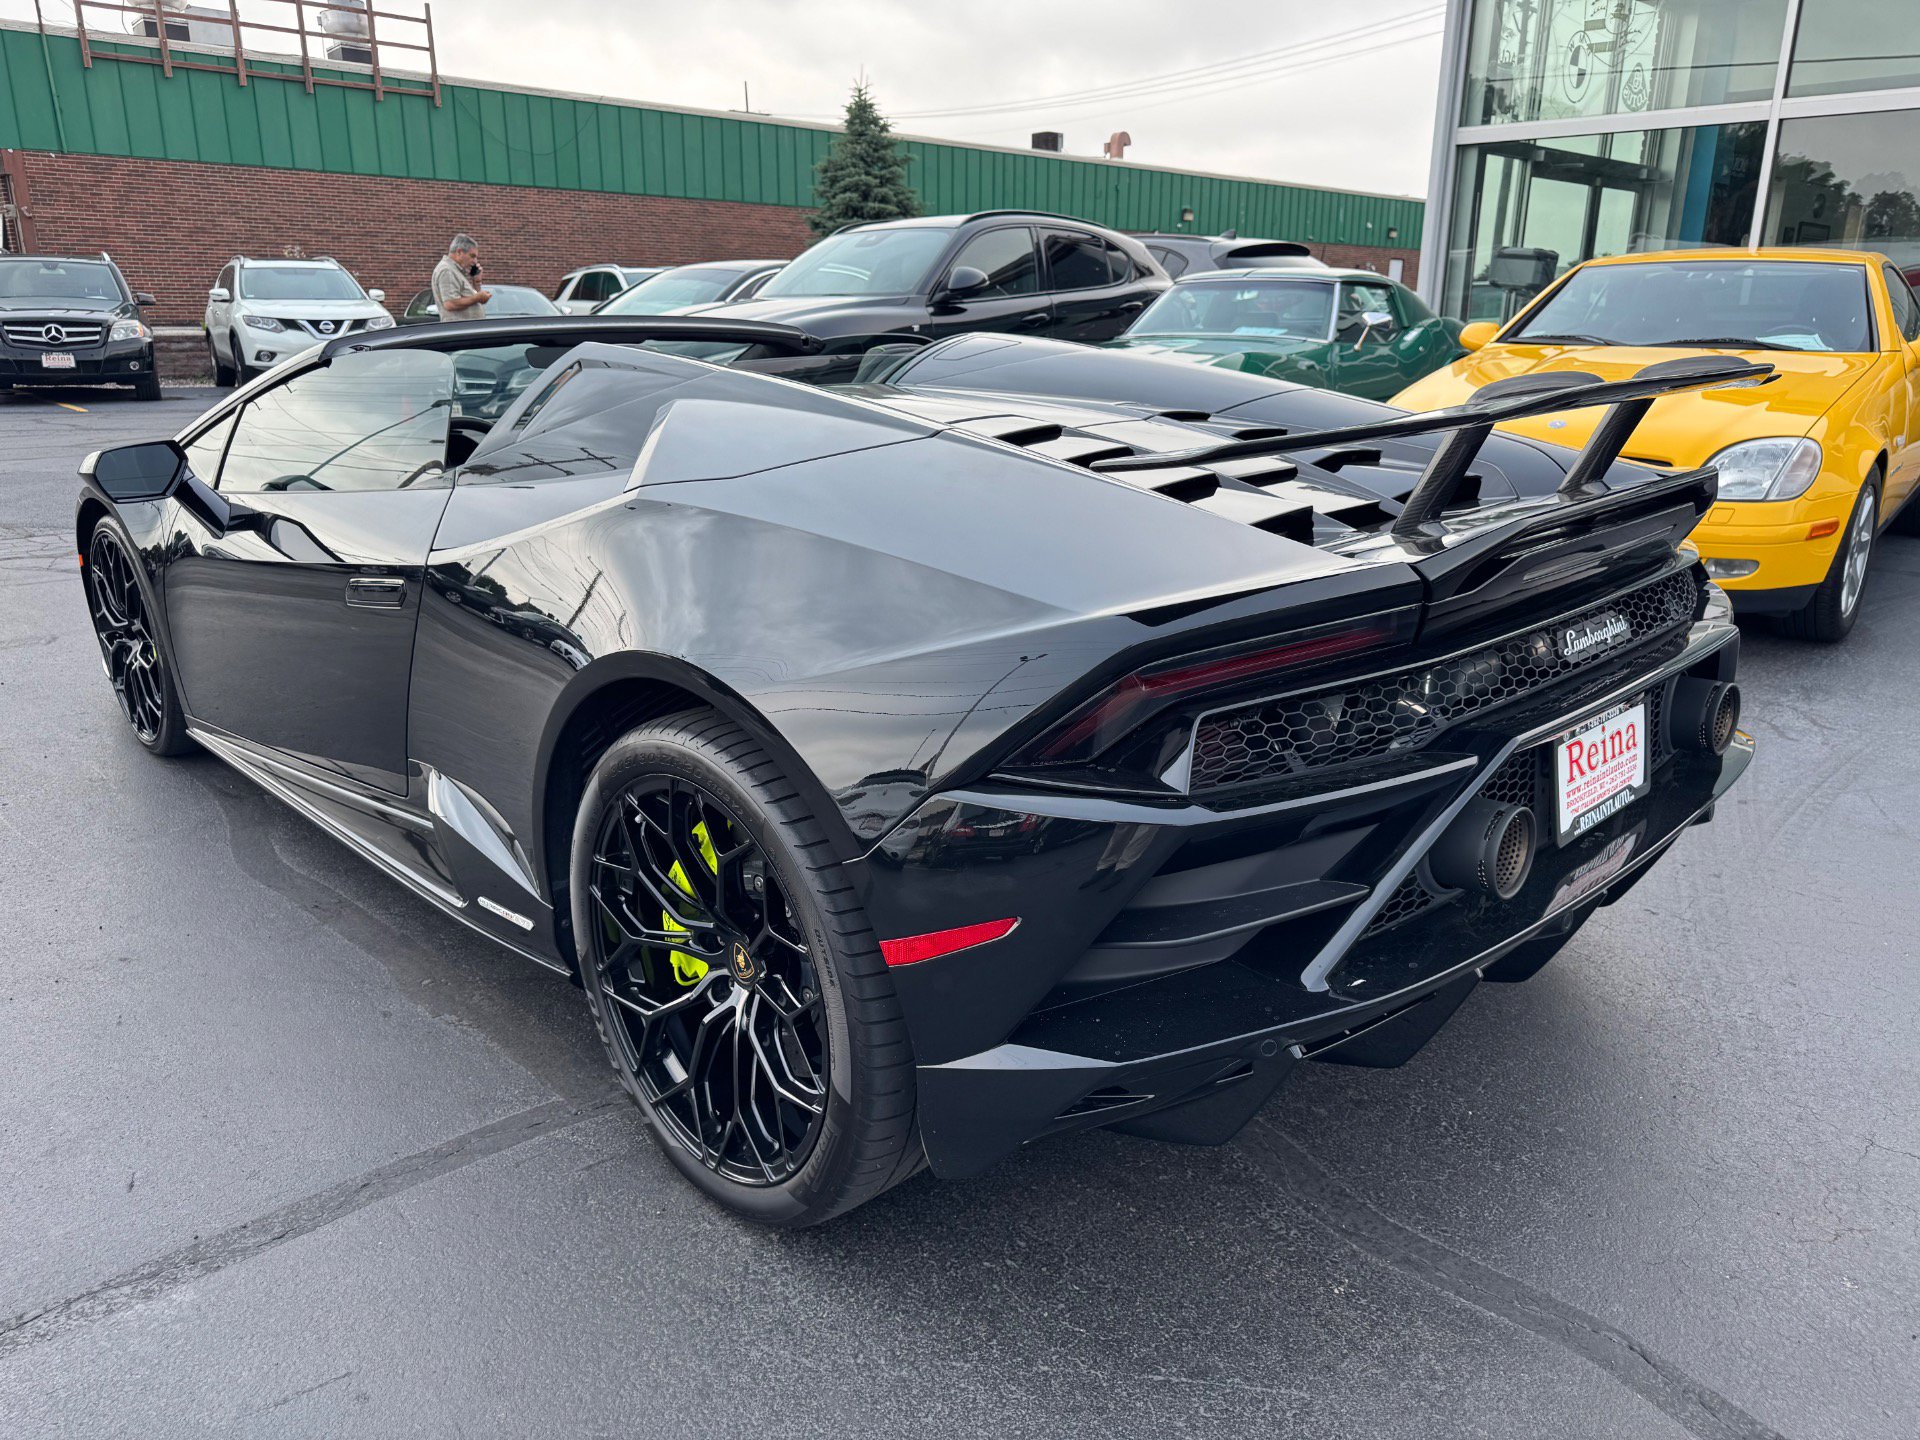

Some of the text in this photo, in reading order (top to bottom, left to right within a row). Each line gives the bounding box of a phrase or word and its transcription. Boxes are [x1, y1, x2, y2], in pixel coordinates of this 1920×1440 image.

[1564, 615, 1627, 656] Lamborghini
[1566, 722, 1637, 784] Reina
[1566, 753, 1638, 799] www.reinaintlauto.com
[814, 928, 836, 988] OUTSIDE
